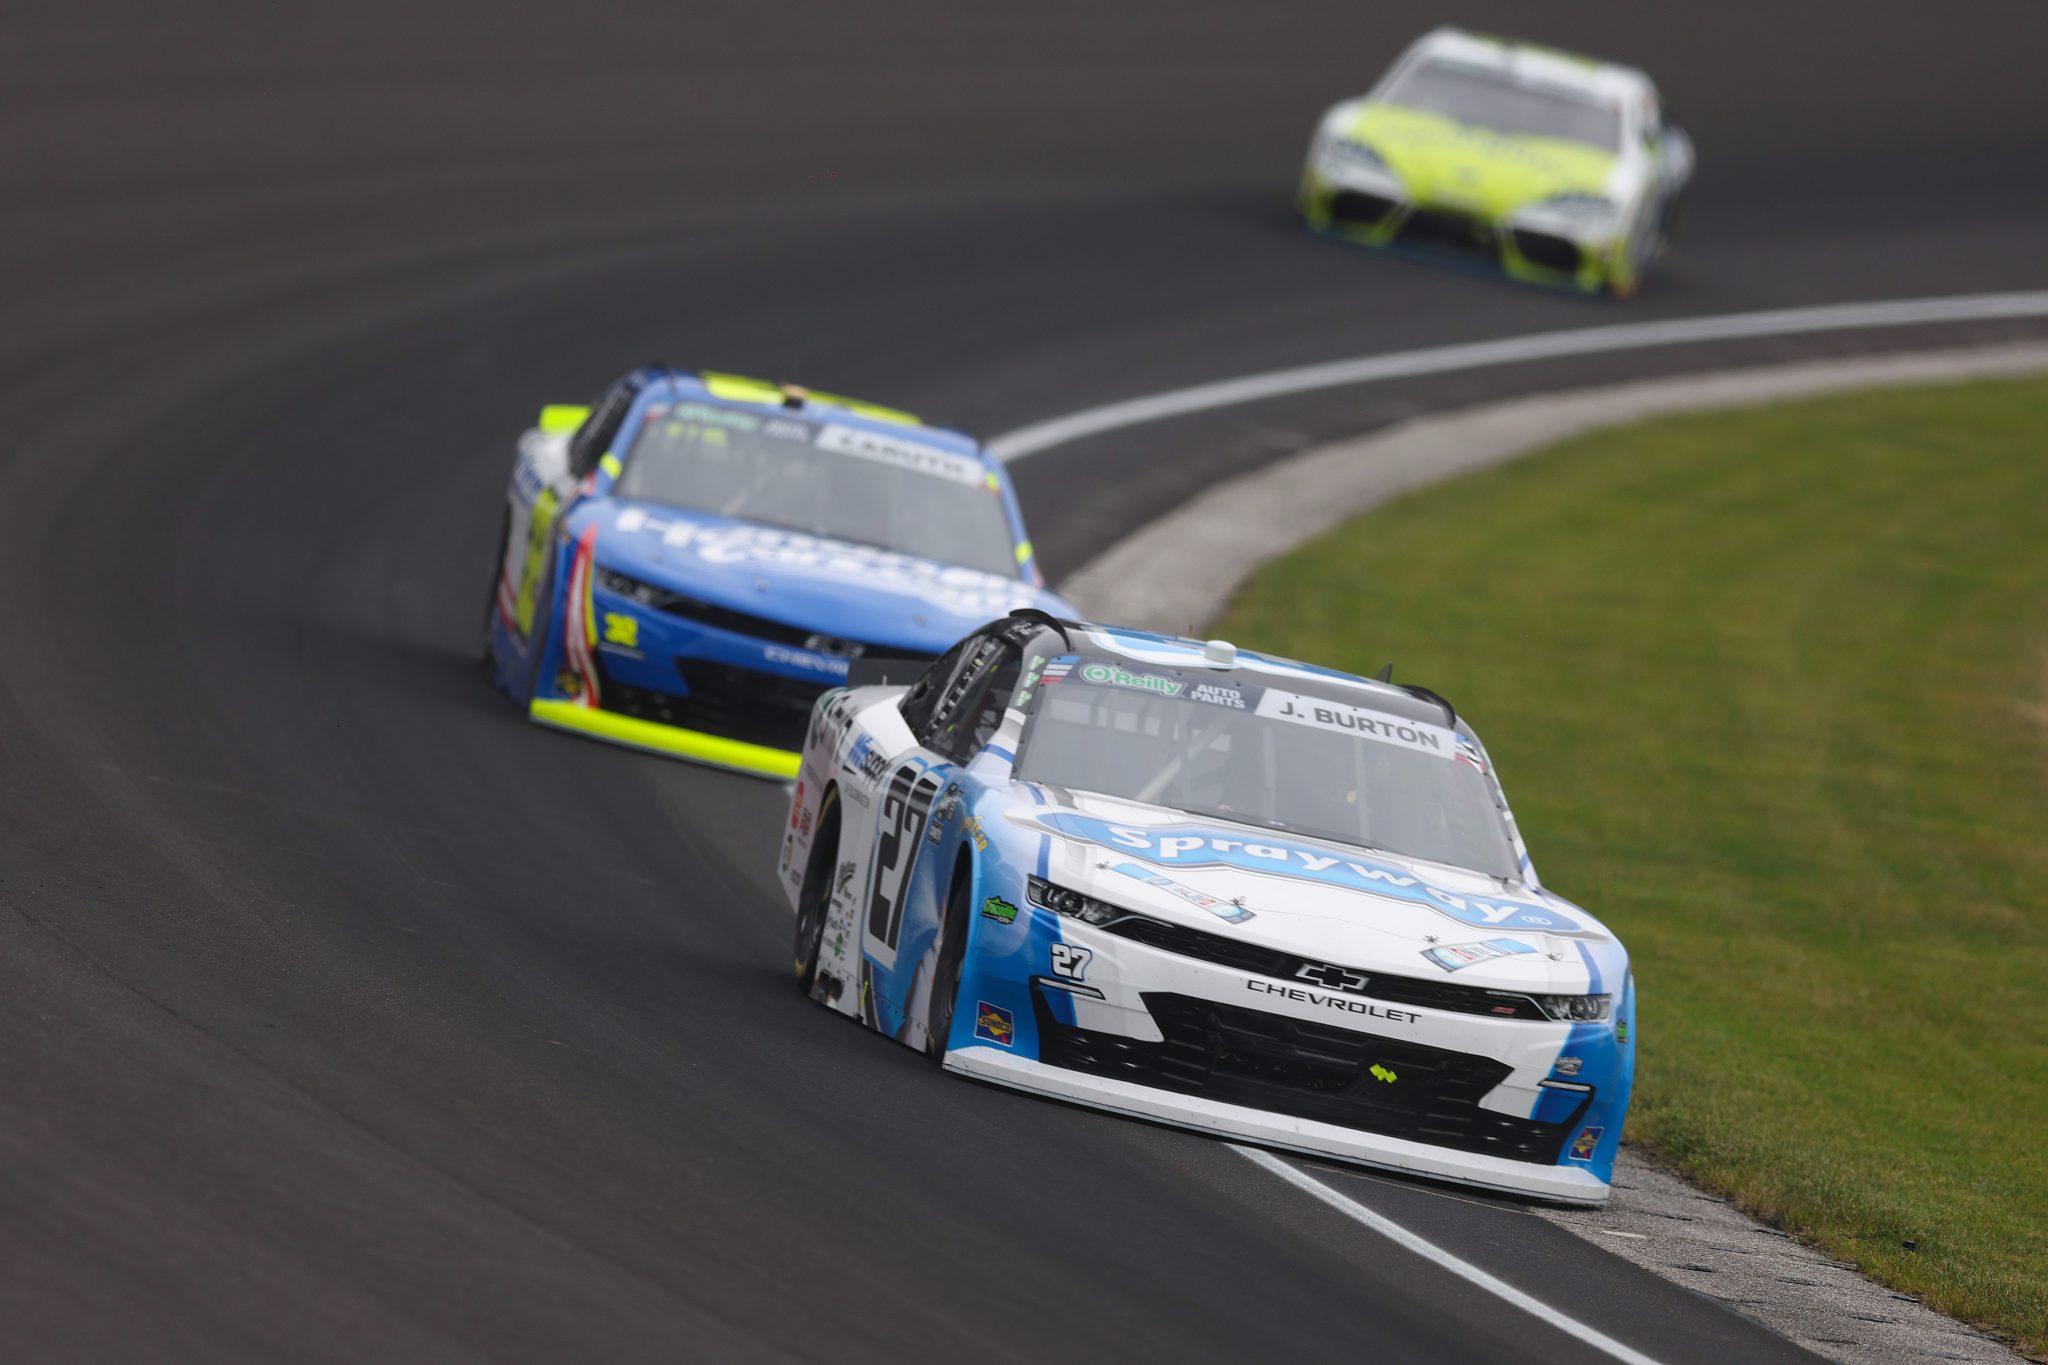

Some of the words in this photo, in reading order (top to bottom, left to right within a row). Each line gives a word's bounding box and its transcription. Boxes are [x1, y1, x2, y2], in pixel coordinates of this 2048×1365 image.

[1081, 663, 1185, 696] O'Reilly
[1196, 683, 1241, 699] AUTO
[1191, 691, 1246, 709] PARTS
[1279, 702, 1304, 718] J.
[1313, 707, 1440, 749] BURTON
[1051, 943, 1092, 982] 27
[1247, 979, 1422, 1024] CHEVROLET
